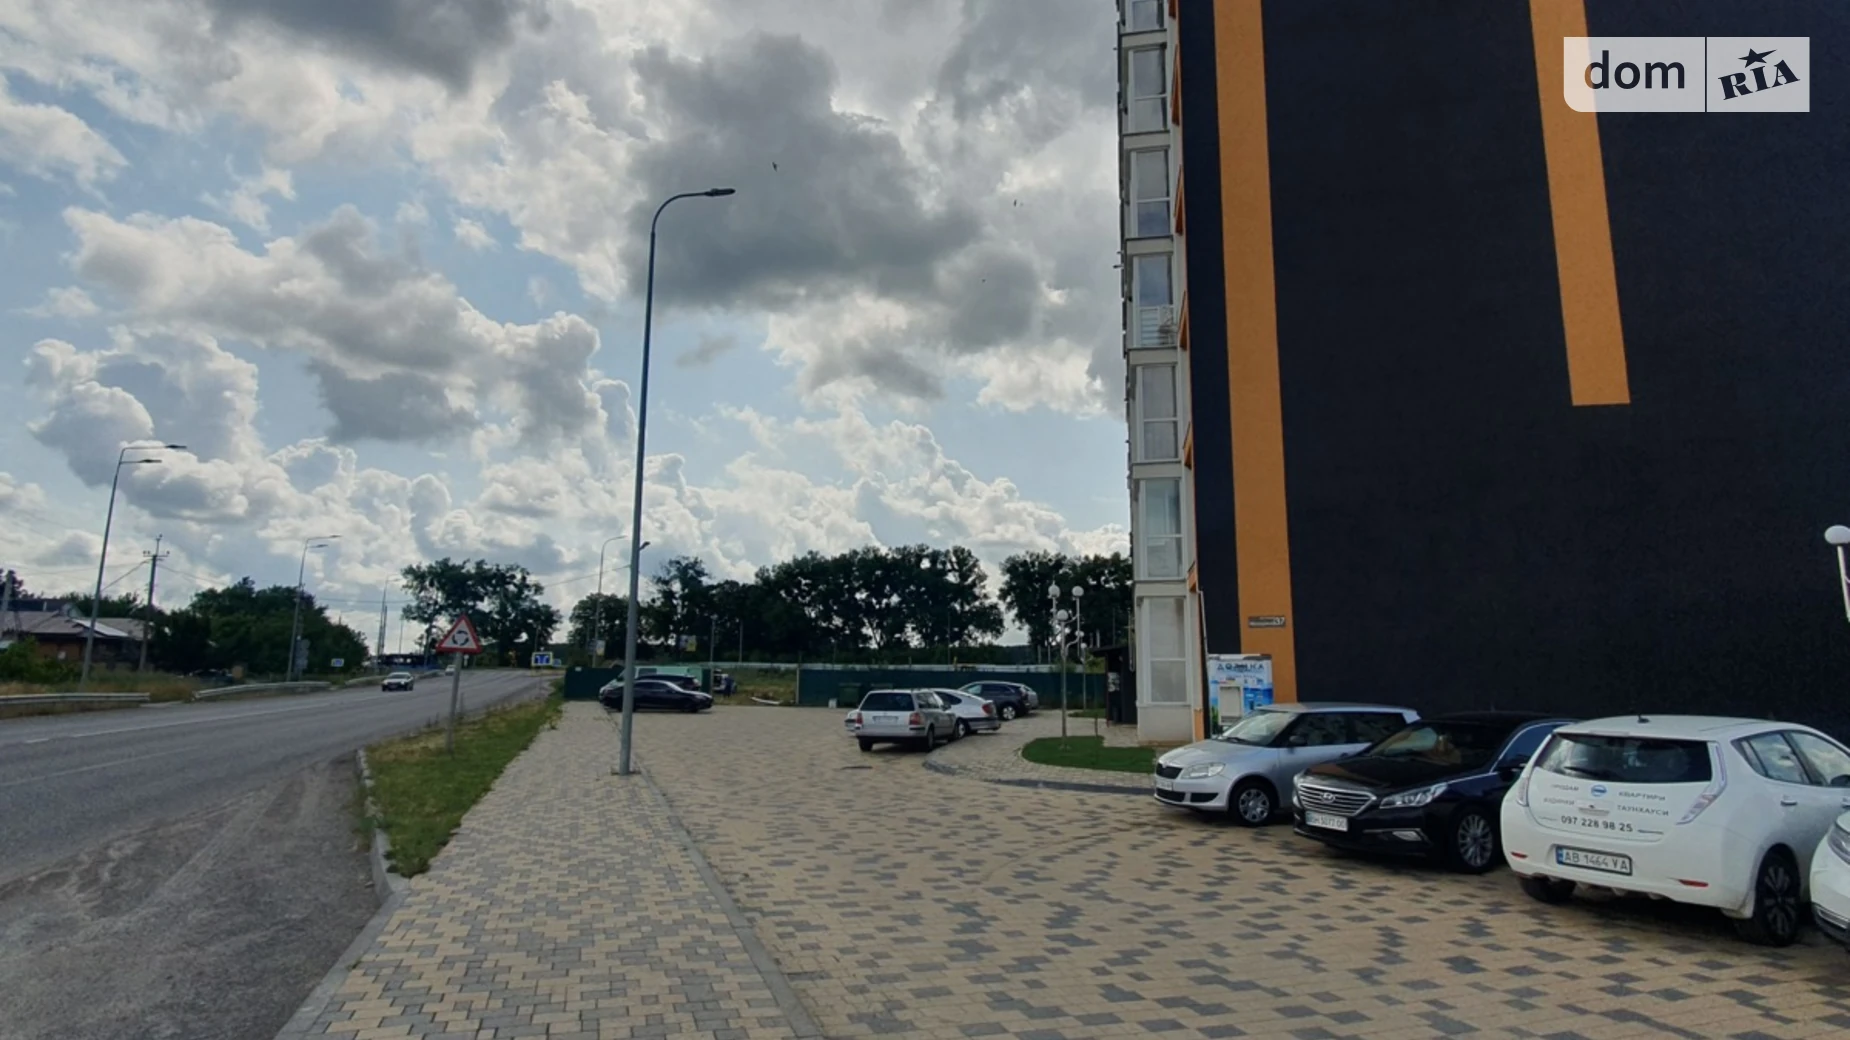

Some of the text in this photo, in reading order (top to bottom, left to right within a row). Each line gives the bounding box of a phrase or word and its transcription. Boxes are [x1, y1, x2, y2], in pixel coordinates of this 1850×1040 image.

[1618, 791, 1666, 802] КВАРТИРИ
[1617, 804, 1669, 816] ТАУНХАУСИ
[1561, 815, 1634, 833] 097 228 98 25
[1565, 851, 1580, 863] AB
